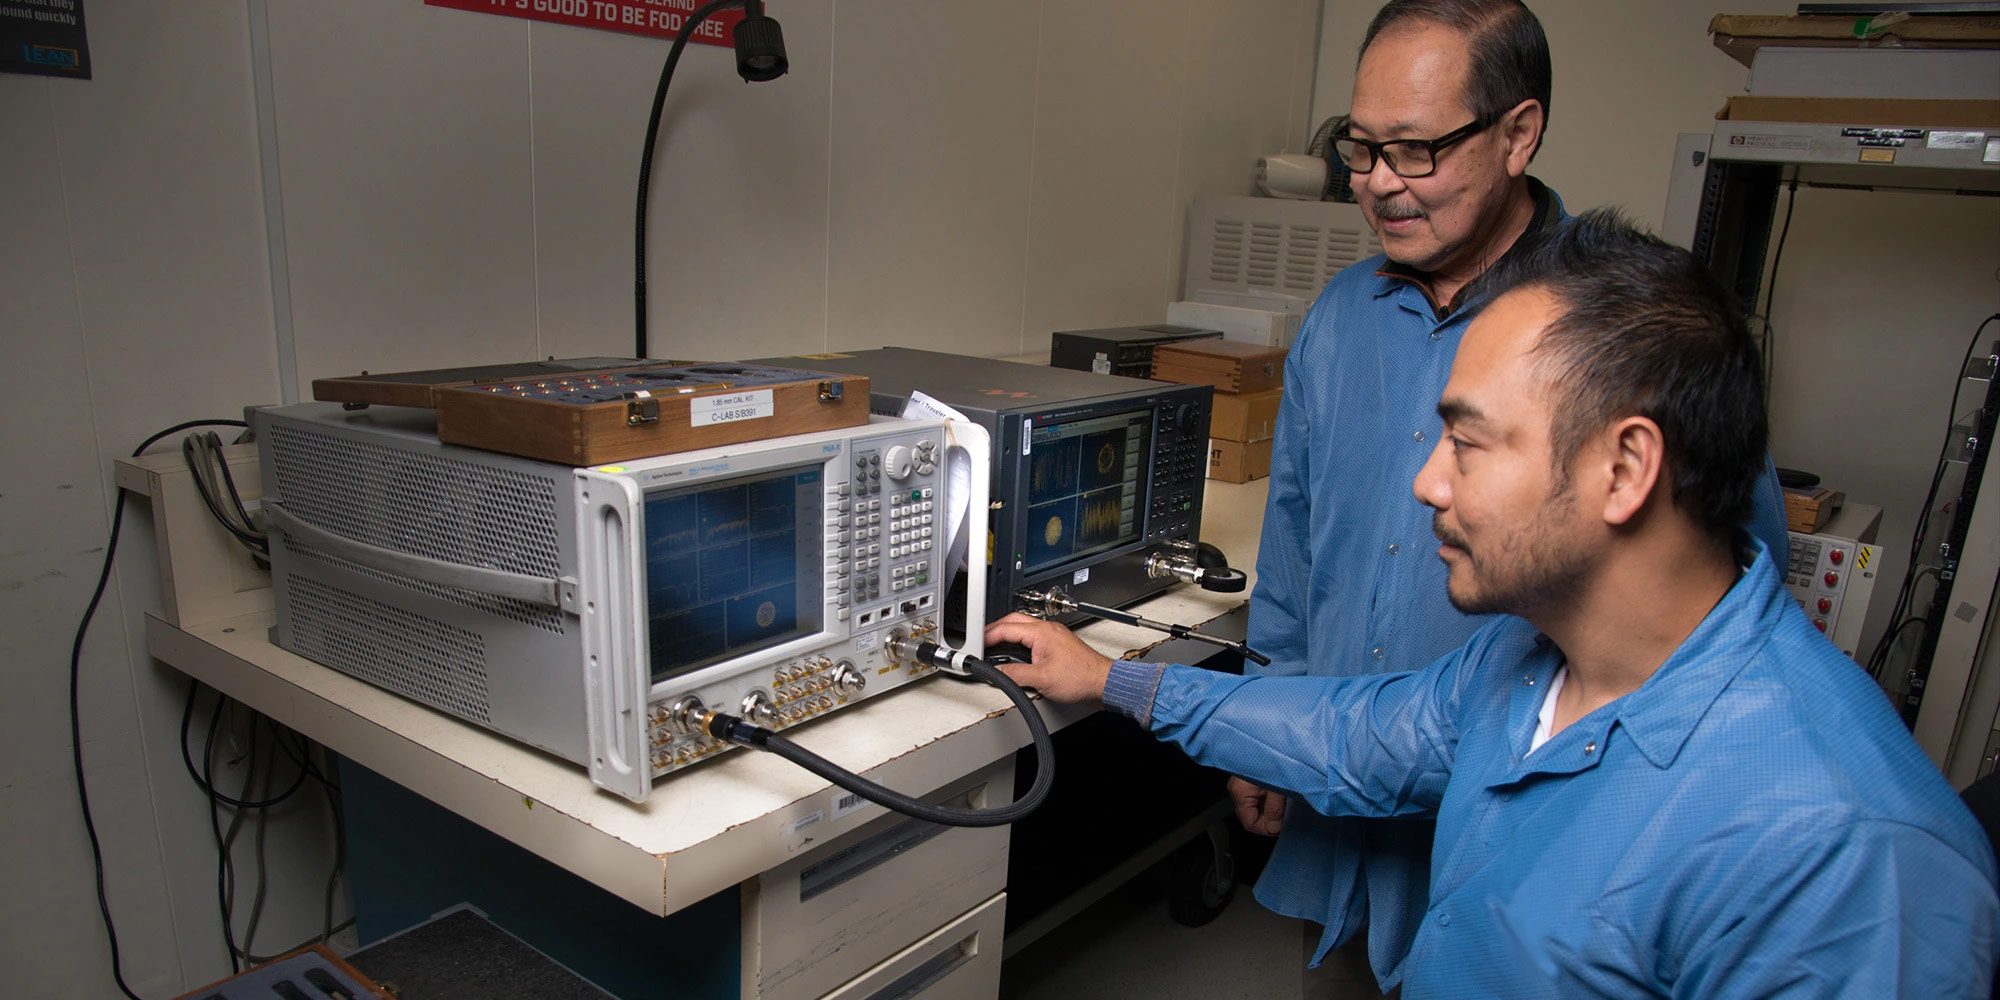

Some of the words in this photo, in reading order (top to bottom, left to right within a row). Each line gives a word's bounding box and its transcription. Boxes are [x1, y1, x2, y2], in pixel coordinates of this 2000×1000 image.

[35, 11, 77, 25] quickly
[533, 0, 588, 17] GOOD
[593, 1, 617, 22] TO
[622, 6, 645, 26] BE
[649, 10, 681, 31] FOD
[685, 16, 724, 38] REE
